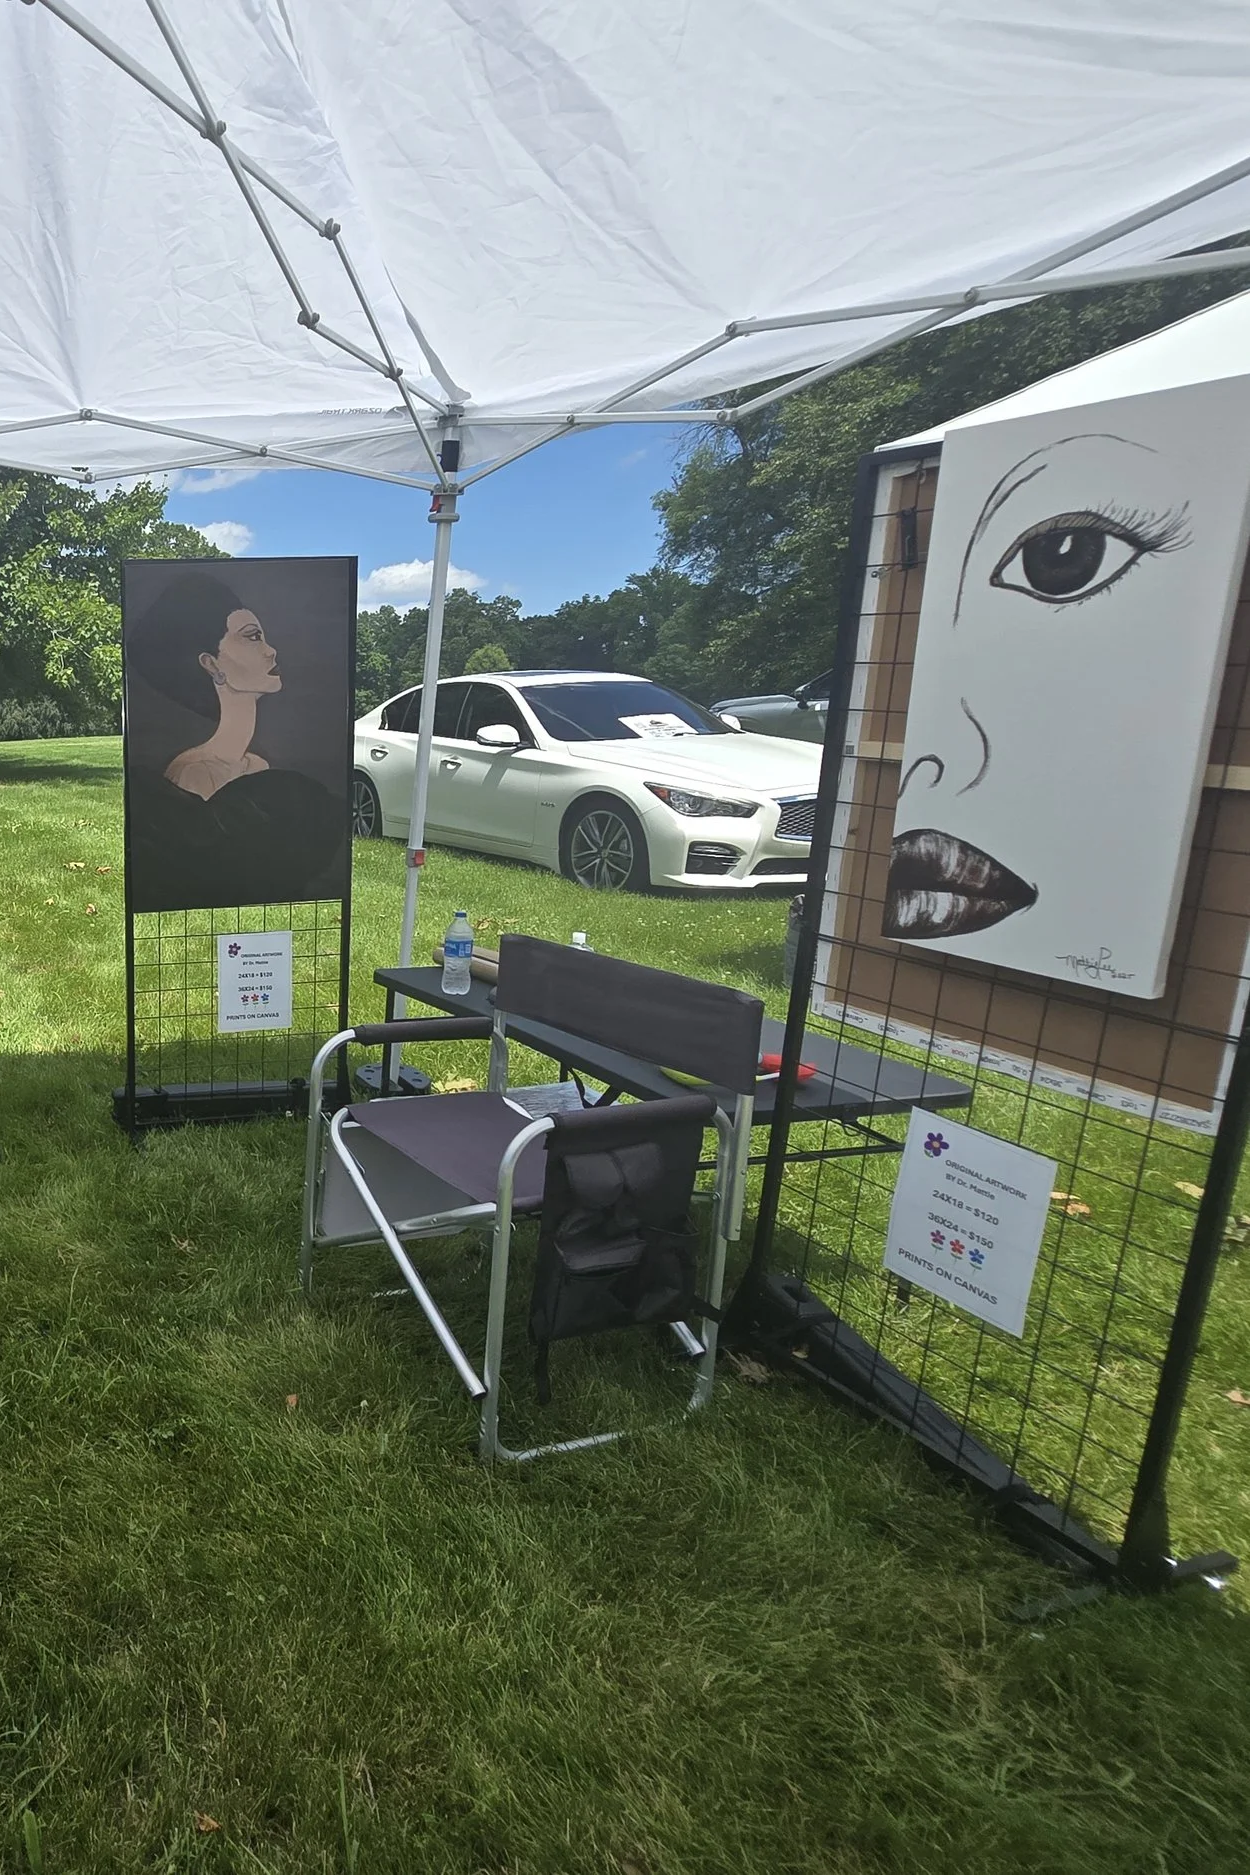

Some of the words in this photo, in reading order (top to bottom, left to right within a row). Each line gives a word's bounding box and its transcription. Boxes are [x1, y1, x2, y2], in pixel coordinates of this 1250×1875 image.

[1075, 1086, 1107, 1102] Canas
[945, 1159, 983, 1182] ORIGINAL
[983, 1176, 1028, 1200] ARTWORK
[945, 1173, 956, 1182] BY
[957, 1177, 968, 1189] Dr.
[969, 1182, 996, 1201] Mattie
[932, 1189, 964, 1210] 24X18
[973, 1208, 1000, 1226] $120
[927, 1211, 959, 1233] 36X24
[968, 1230, 994, 1250] $150
[898, 1247, 934, 1272] PRINTS
[936, 1267, 953, 1281] ON
[954, 1276, 998, 1305] CANVAS
